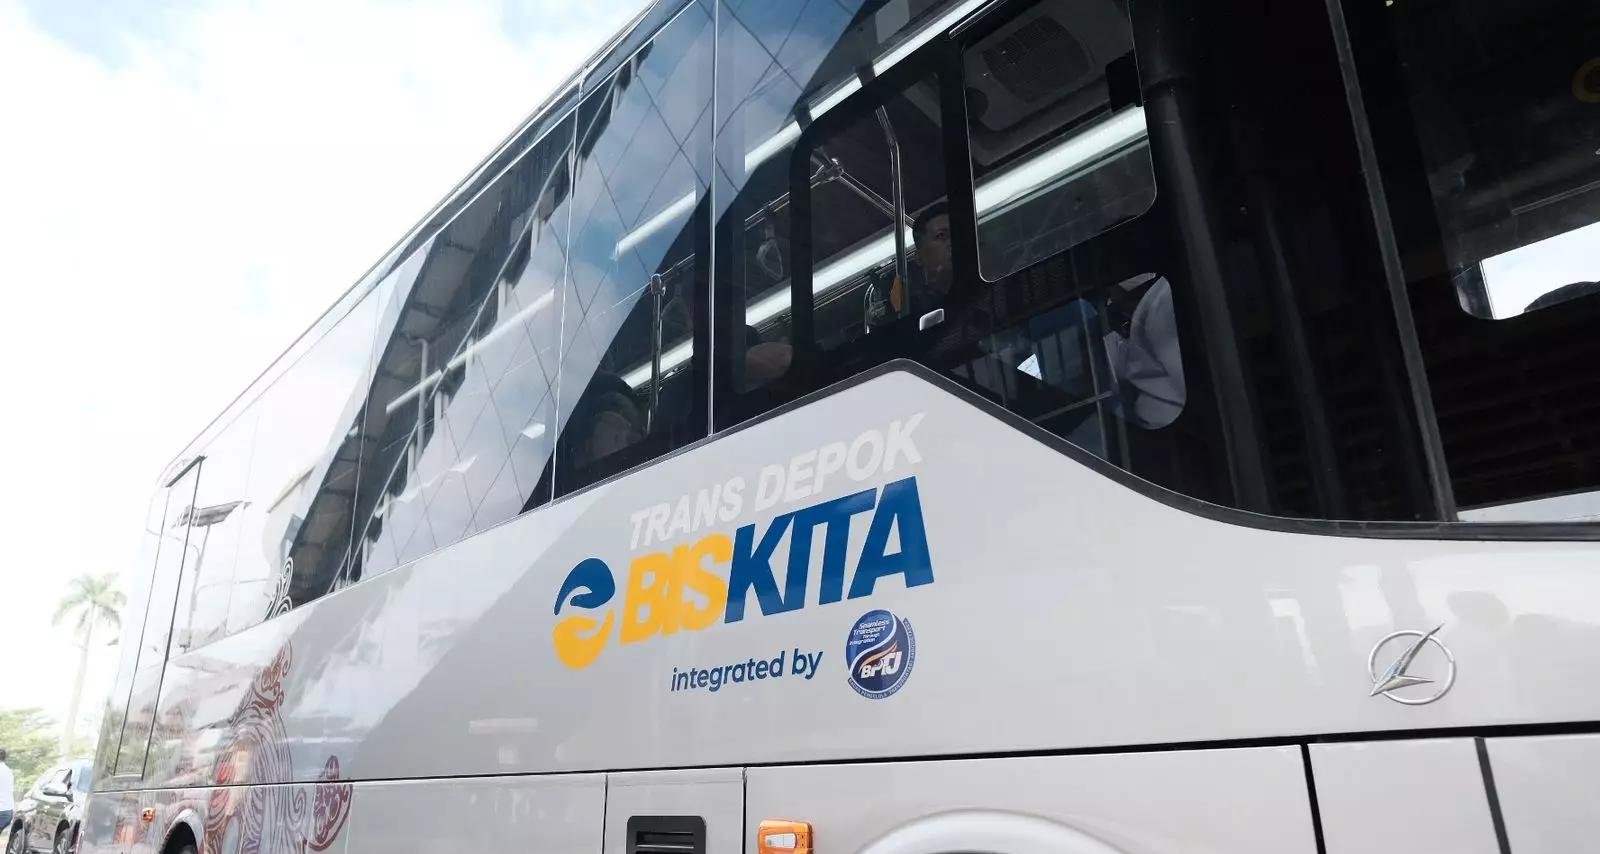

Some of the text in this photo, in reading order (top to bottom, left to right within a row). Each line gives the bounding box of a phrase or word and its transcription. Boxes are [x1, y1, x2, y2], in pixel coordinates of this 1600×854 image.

[630, 412, 927, 550] TRANS DEPOK
[619, 476, 935, 645] BISKITA
[853, 626, 886, 636] Transport
[859, 619, 889, 629] Seamless
[671, 649, 824, 692] integrated by
[860, 651, 903, 679] BPTJ
